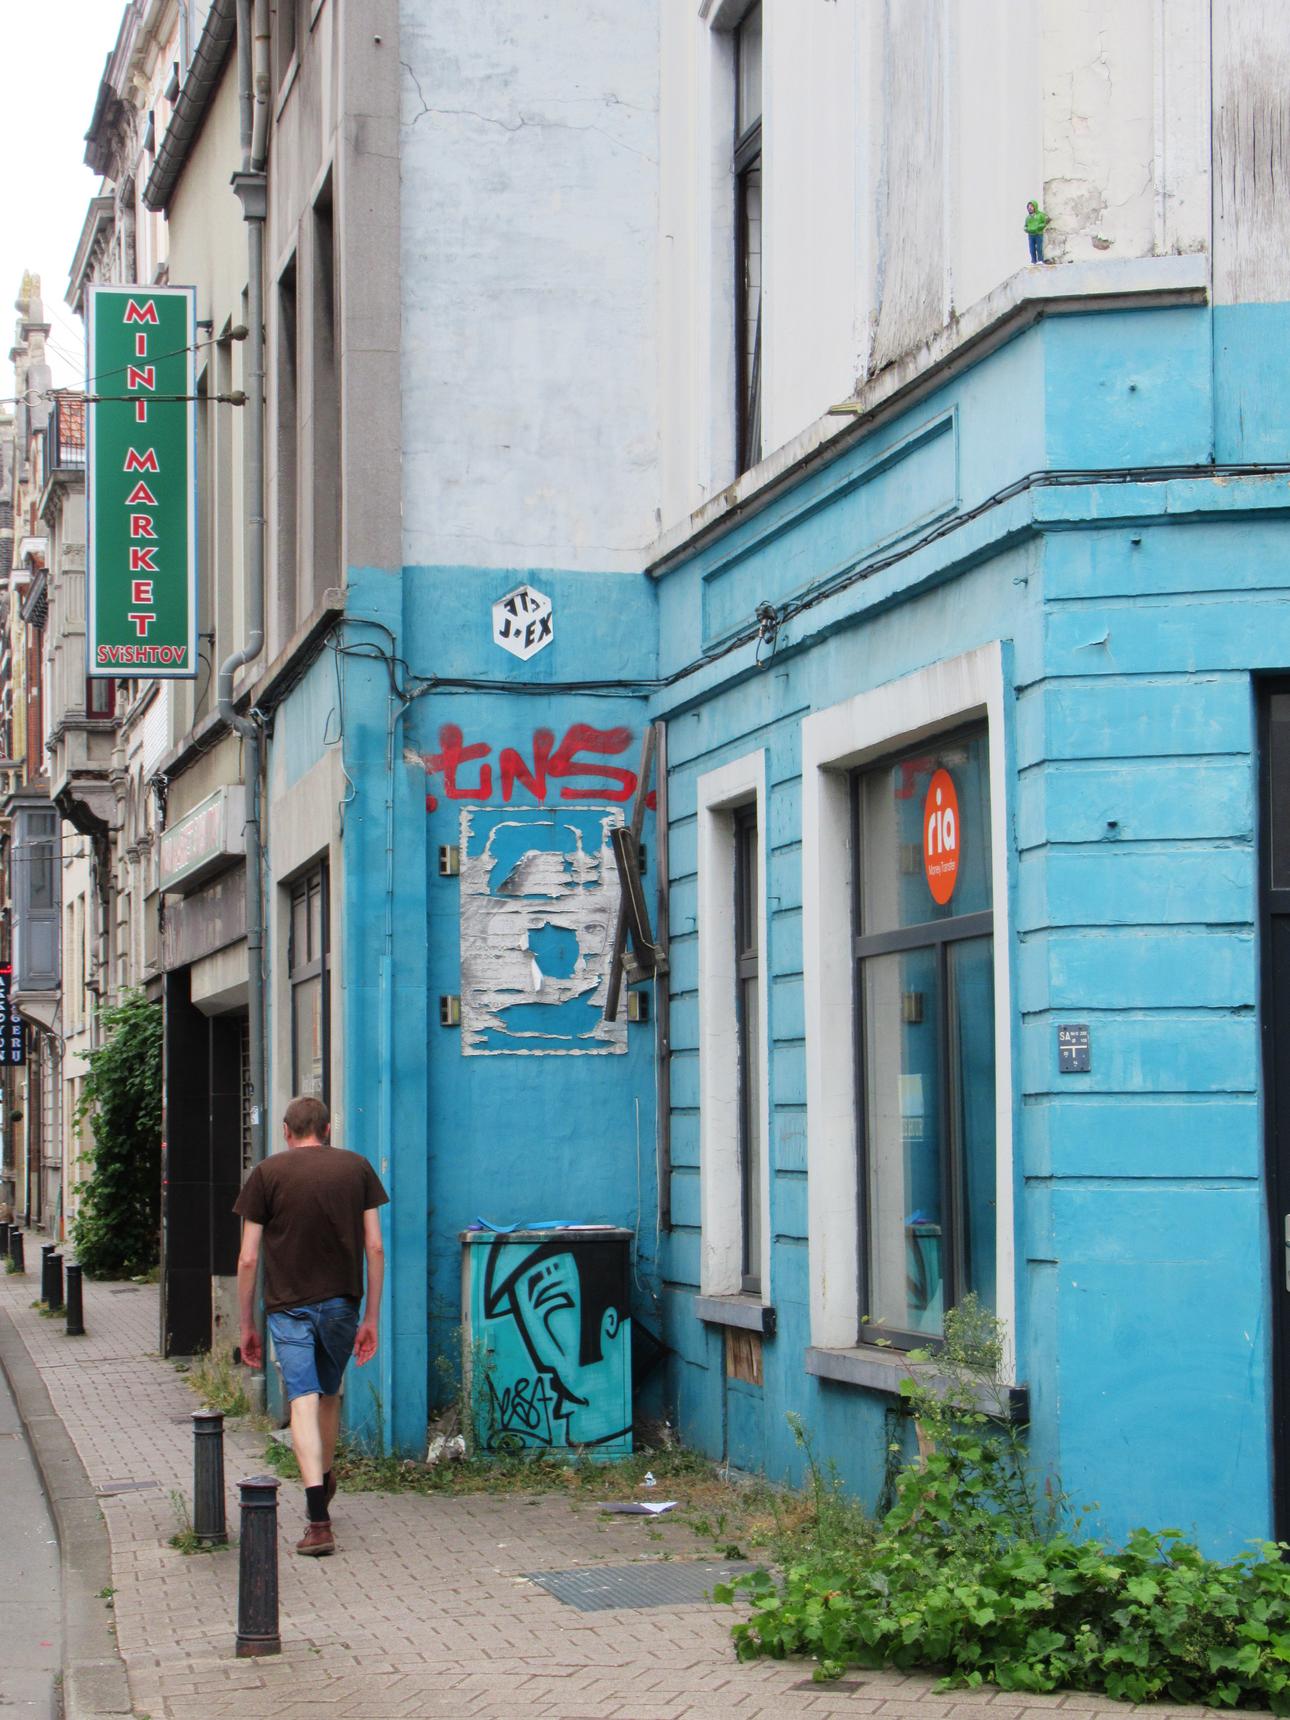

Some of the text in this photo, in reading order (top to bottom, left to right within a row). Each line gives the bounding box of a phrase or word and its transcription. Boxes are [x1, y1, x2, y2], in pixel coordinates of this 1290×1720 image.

[123, 298, 161, 637] MINI MARKET
[928, 787, 956, 856] ria
